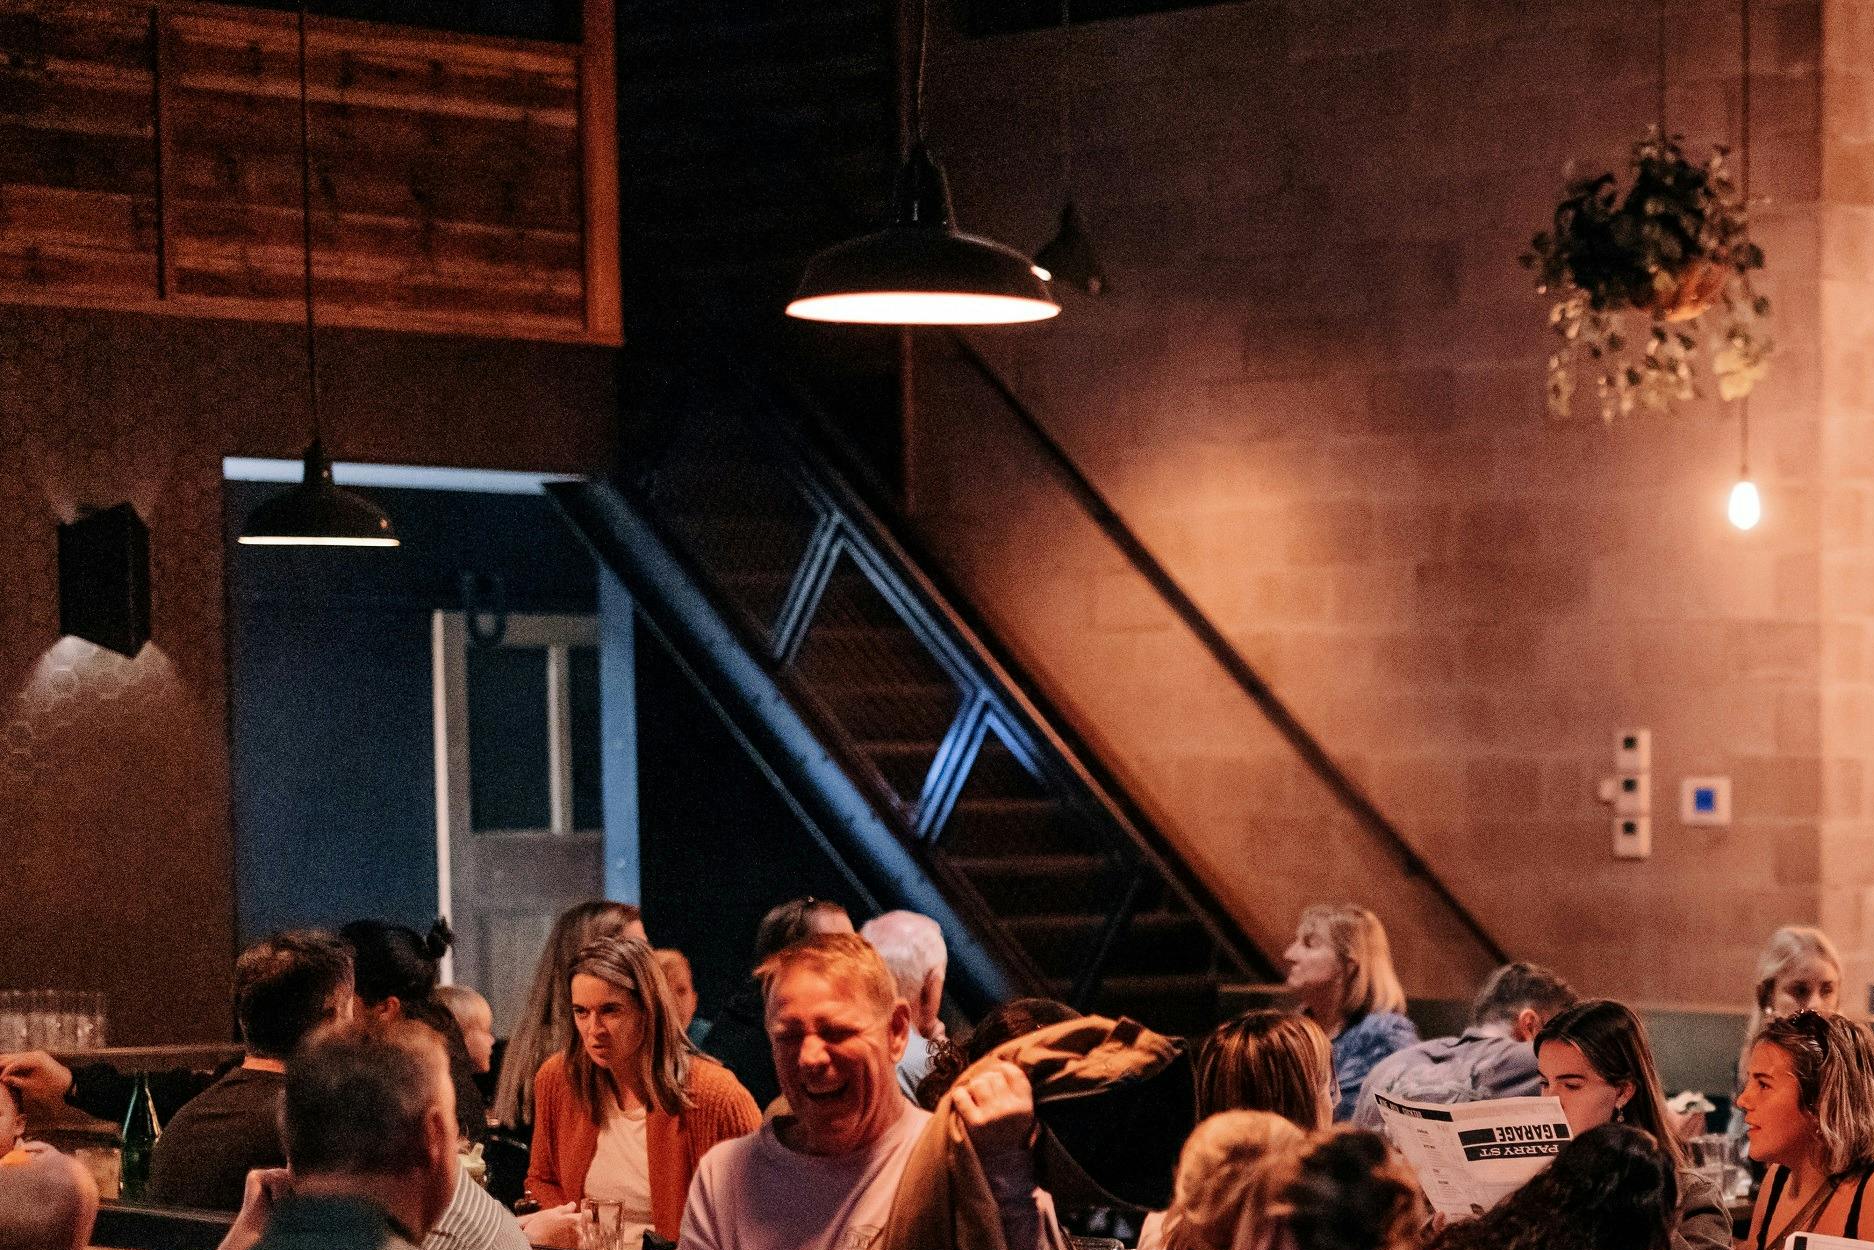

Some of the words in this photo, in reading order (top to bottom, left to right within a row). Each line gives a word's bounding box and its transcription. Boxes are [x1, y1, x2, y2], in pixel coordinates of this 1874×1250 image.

[1496, 1124, 1554, 1142] GARAGE
[1479, 1147, 1501, 1157] ST
[1503, 1144, 1559, 1156] PARRY
